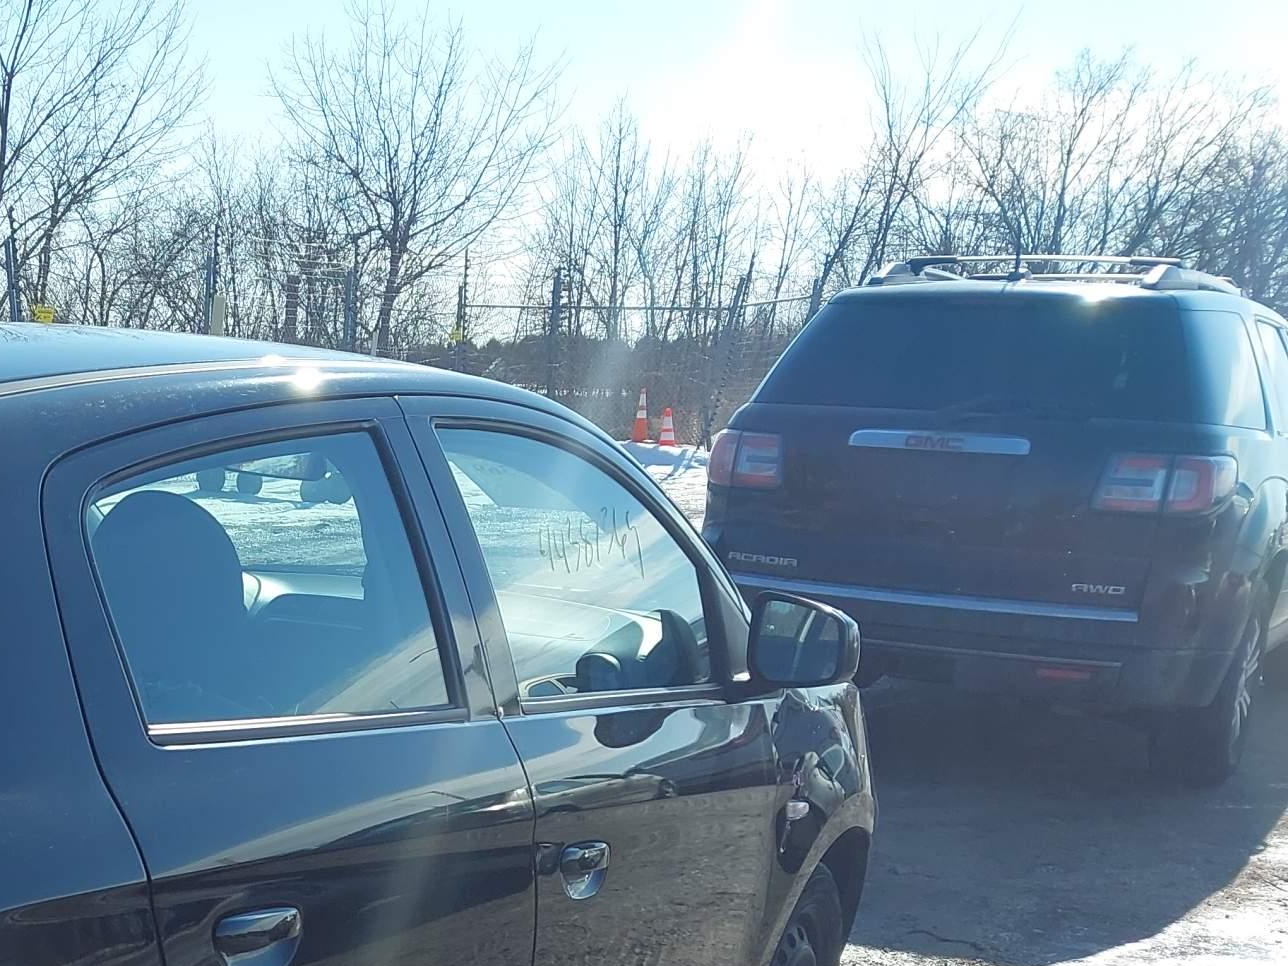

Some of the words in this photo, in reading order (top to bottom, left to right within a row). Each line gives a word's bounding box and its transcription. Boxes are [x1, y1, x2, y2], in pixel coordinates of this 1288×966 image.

[905, 435, 966, 450] GMC
[728, 551, 798, 567] ACADIA
[1072, 583, 1126, 595] AWD
